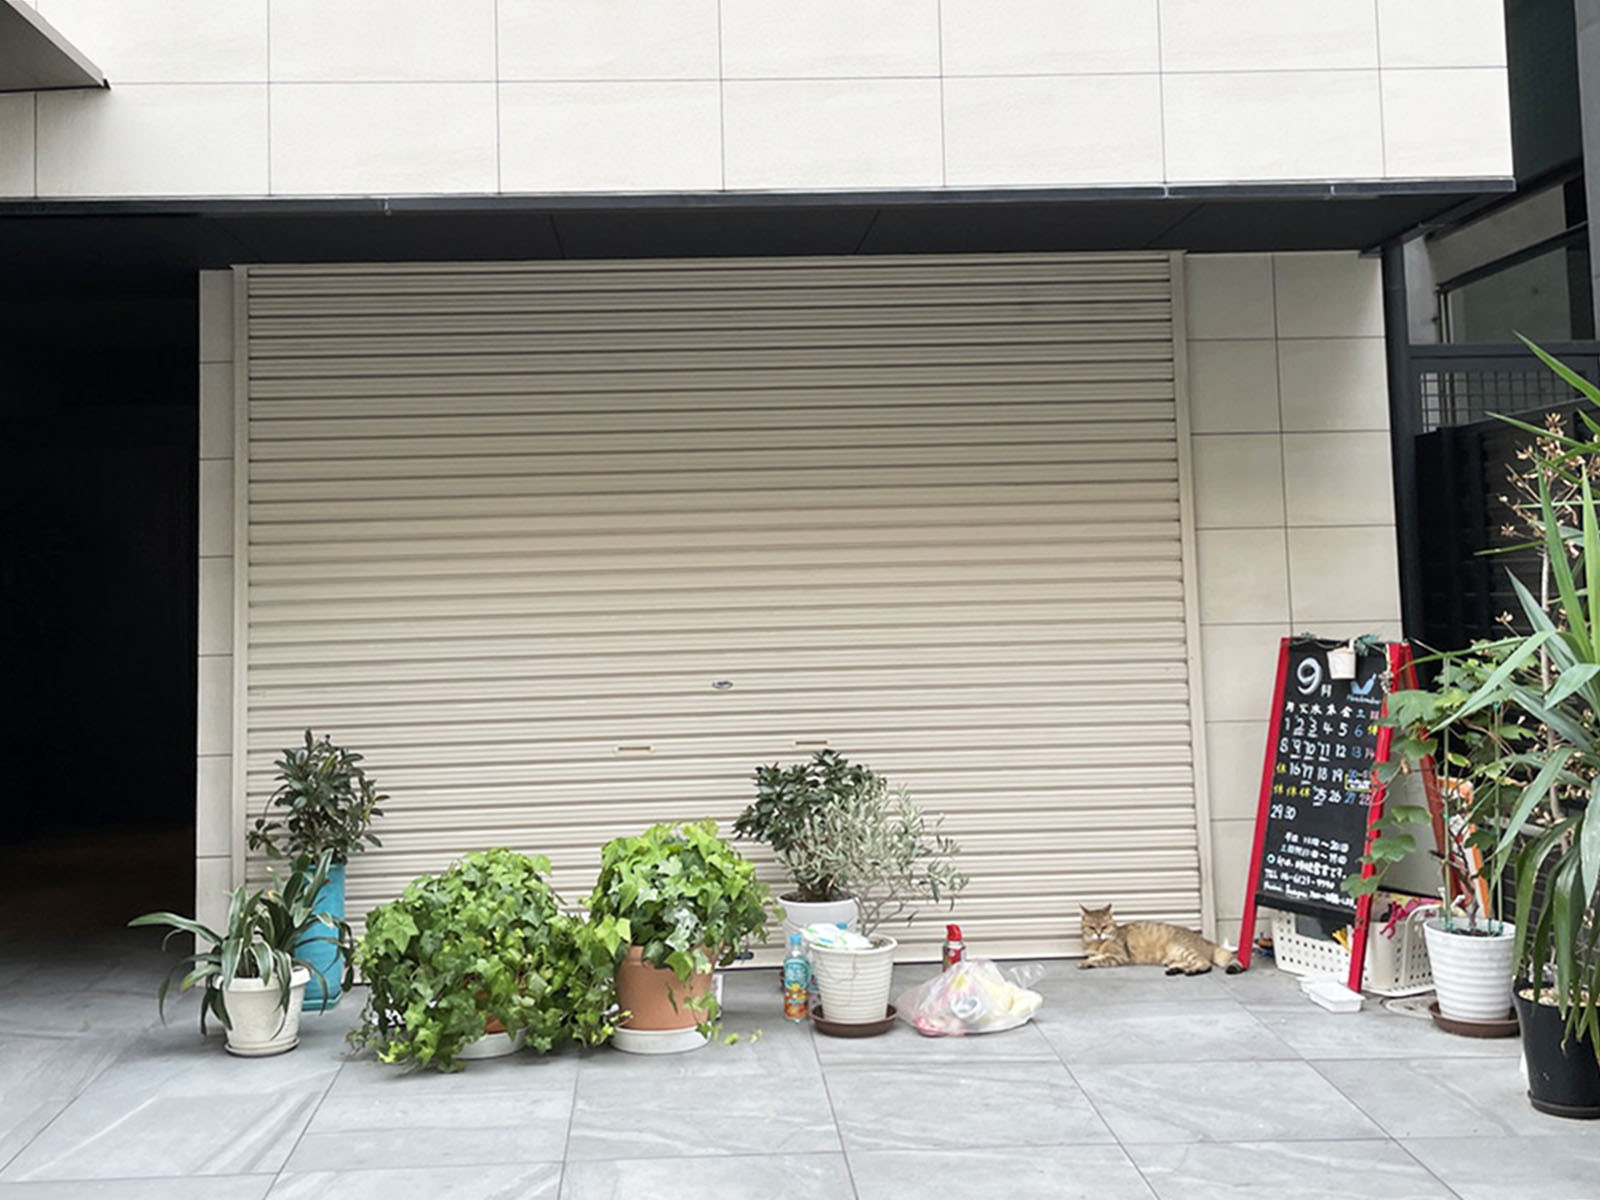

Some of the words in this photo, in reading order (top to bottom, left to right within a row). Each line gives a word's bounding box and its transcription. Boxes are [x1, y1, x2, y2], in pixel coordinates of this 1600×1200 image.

[1285, 701, 1295, 713] 月
[1311, 703, 1323, 715] 水
[1326, 704, 1337, 715] 木
[1340, 705, 1352, 718] 金
[1356, 708, 1367, 719] 土
[1284, 717, 1291, 731] 1
[1294, 717, 1305, 733] 2
[1308, 716, 1318, 734] 3
[1322, 721, 1333, 735] 4
[1338, 722, 1349, 737] 5
[1354, 724, 1364, 737] 6
[1279, 737, 1289, 753] 8
[1292, 738, 1302, 754] 9
[1303, 740, 1316, 755] 10
[1319, 742, 1331, 757] 11
[1335, 743, 1347, 758] 12
[1352, 745, 1362, 759] 13
[1289, 762, 1301, 776] 16
[1302, 763, 1314, 779] 17
[1317, 766, 1328, 781] 18
[1332, 768, 1344, 783] 19
[1313, 787, 1327, 802] 25
[1328, 789, 1342, 803] 26
[1344, 791, 1356, 804] 27
[1270, 803, 1284, 819] 29
[1284, 805, 1297, 820] 30
